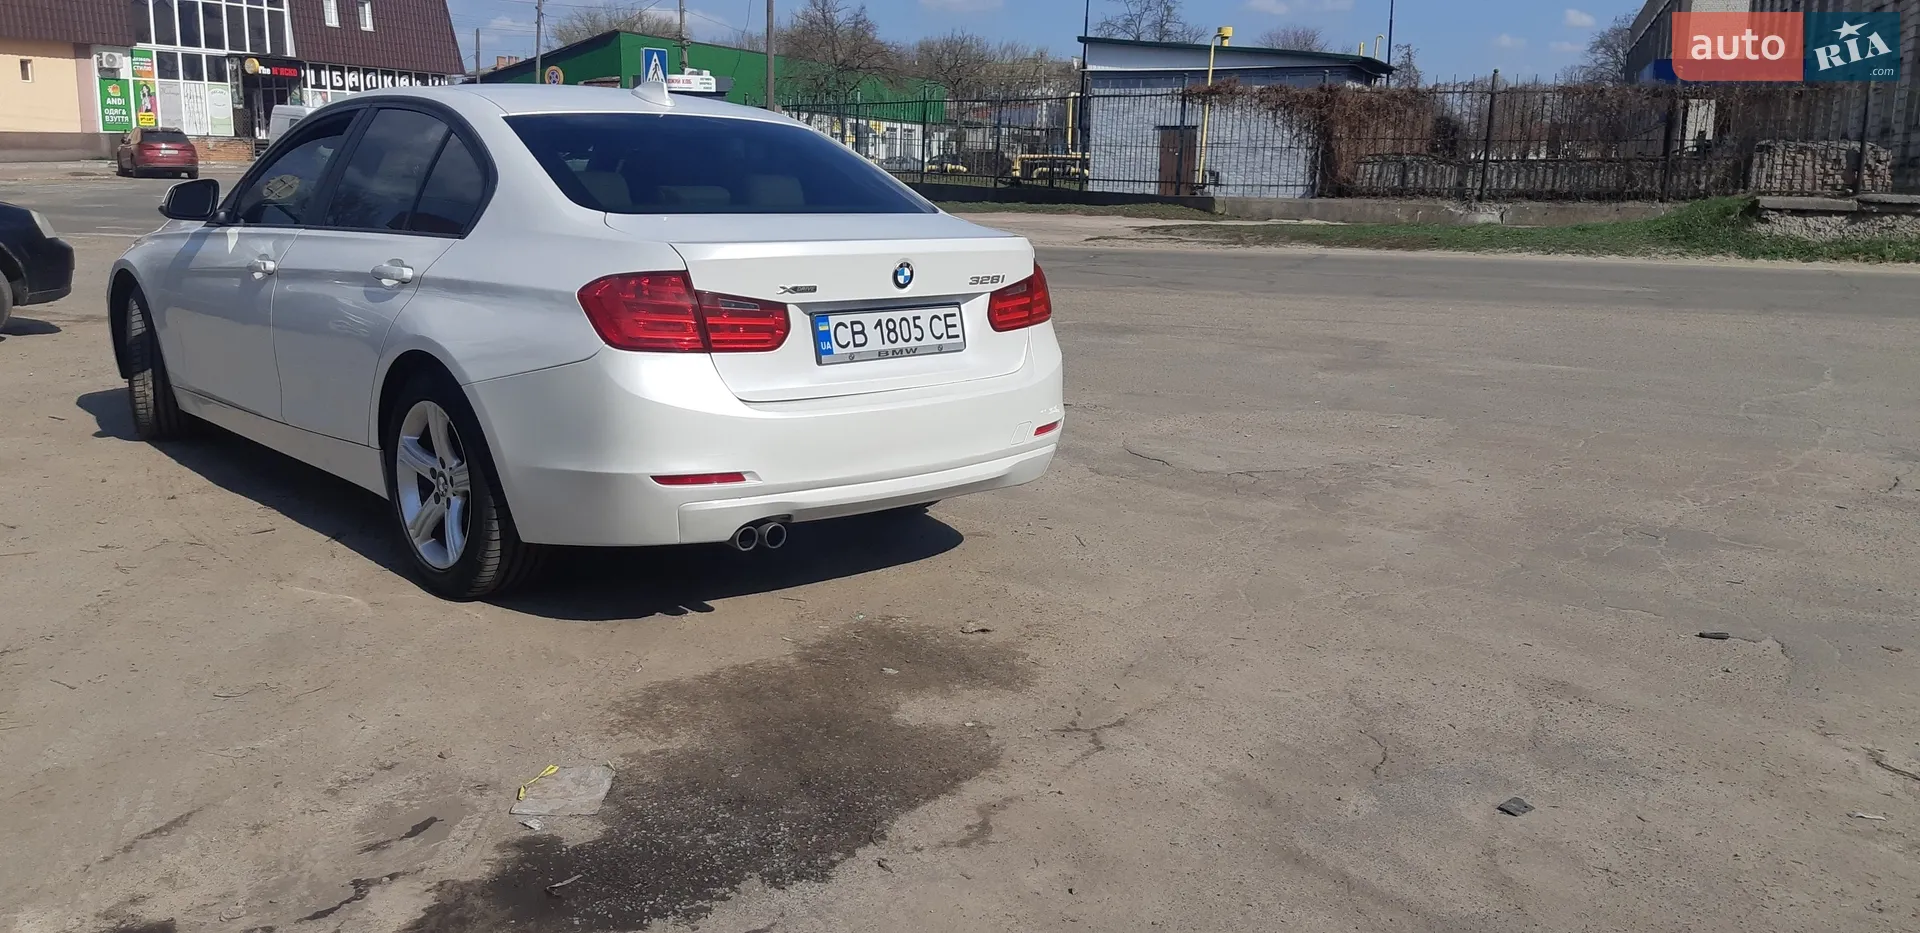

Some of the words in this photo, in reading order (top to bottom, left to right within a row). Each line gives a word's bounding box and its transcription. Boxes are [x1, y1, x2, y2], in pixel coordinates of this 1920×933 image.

[106, 97, 125, 105] ANDI
[833, 320, 868, 349] CB
[873, 315, 924, 346] 1805
[929, 313, 960, 341] CE
[820, 341, 832, 351] UA
[877, 346, 918, 358] BMW
